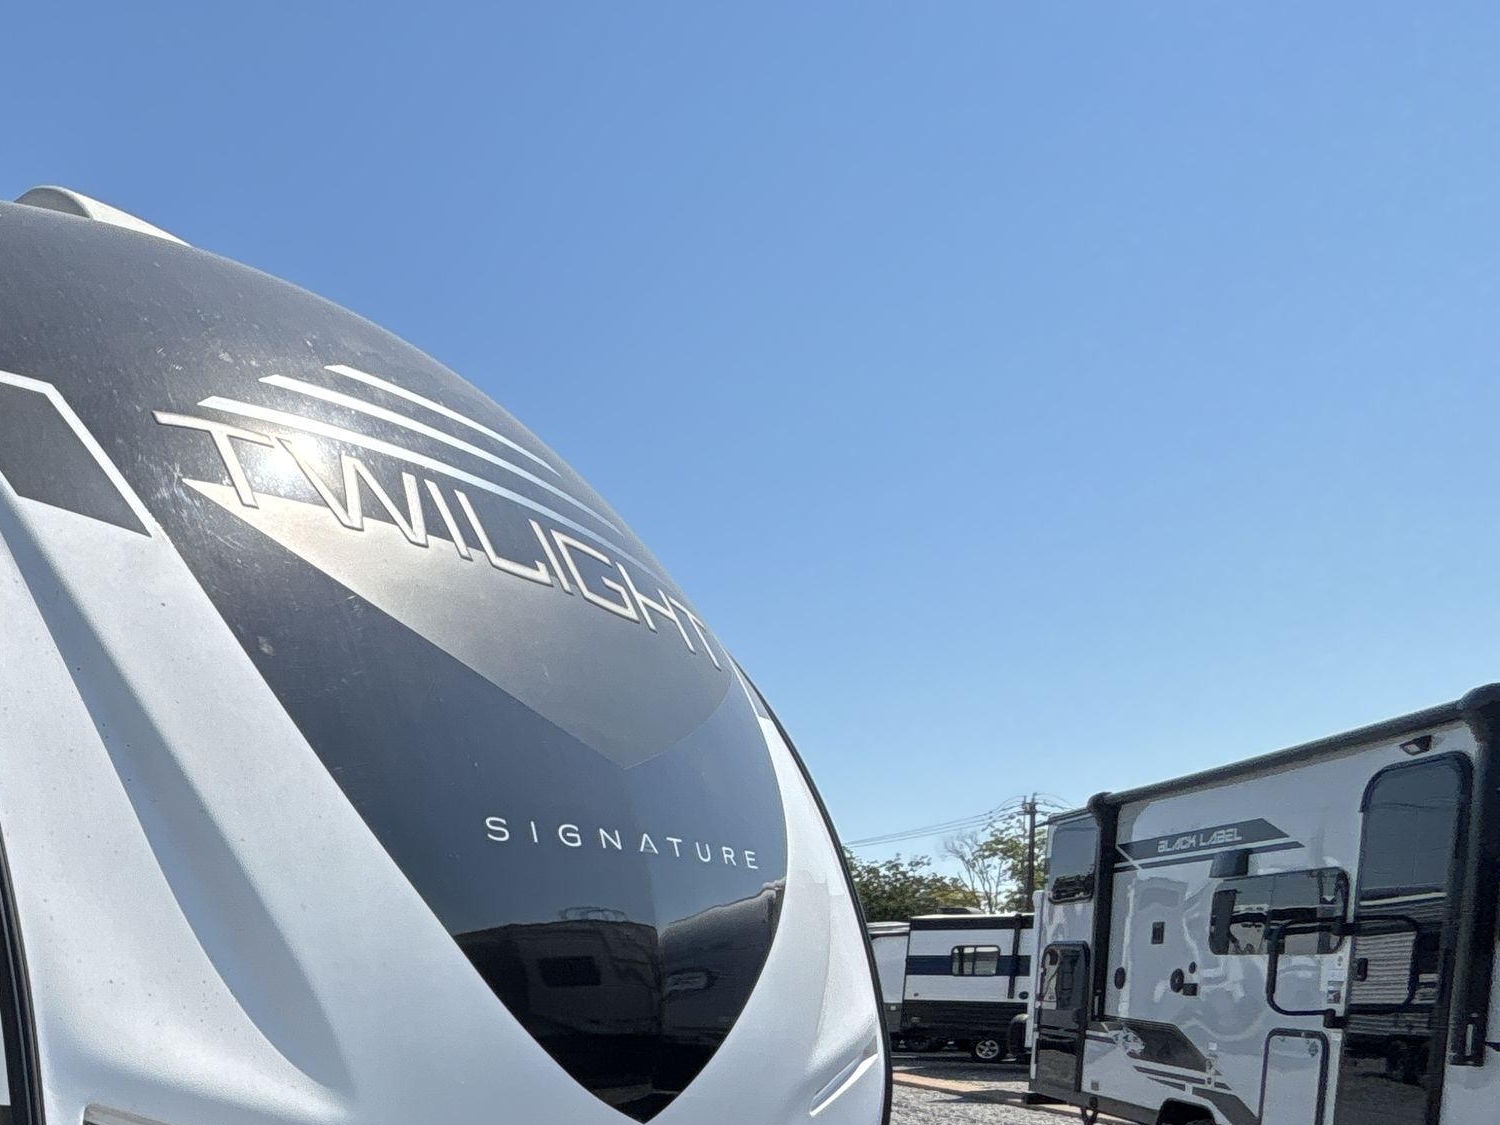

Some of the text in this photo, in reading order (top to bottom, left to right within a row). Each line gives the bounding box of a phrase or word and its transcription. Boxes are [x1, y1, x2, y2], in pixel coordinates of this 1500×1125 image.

[150, 409, 722, 672] TWILIGHT
[485, 816, 759, 870] SIGNATURE
[1157, 827, 1243, 853] BLACK LABEL
